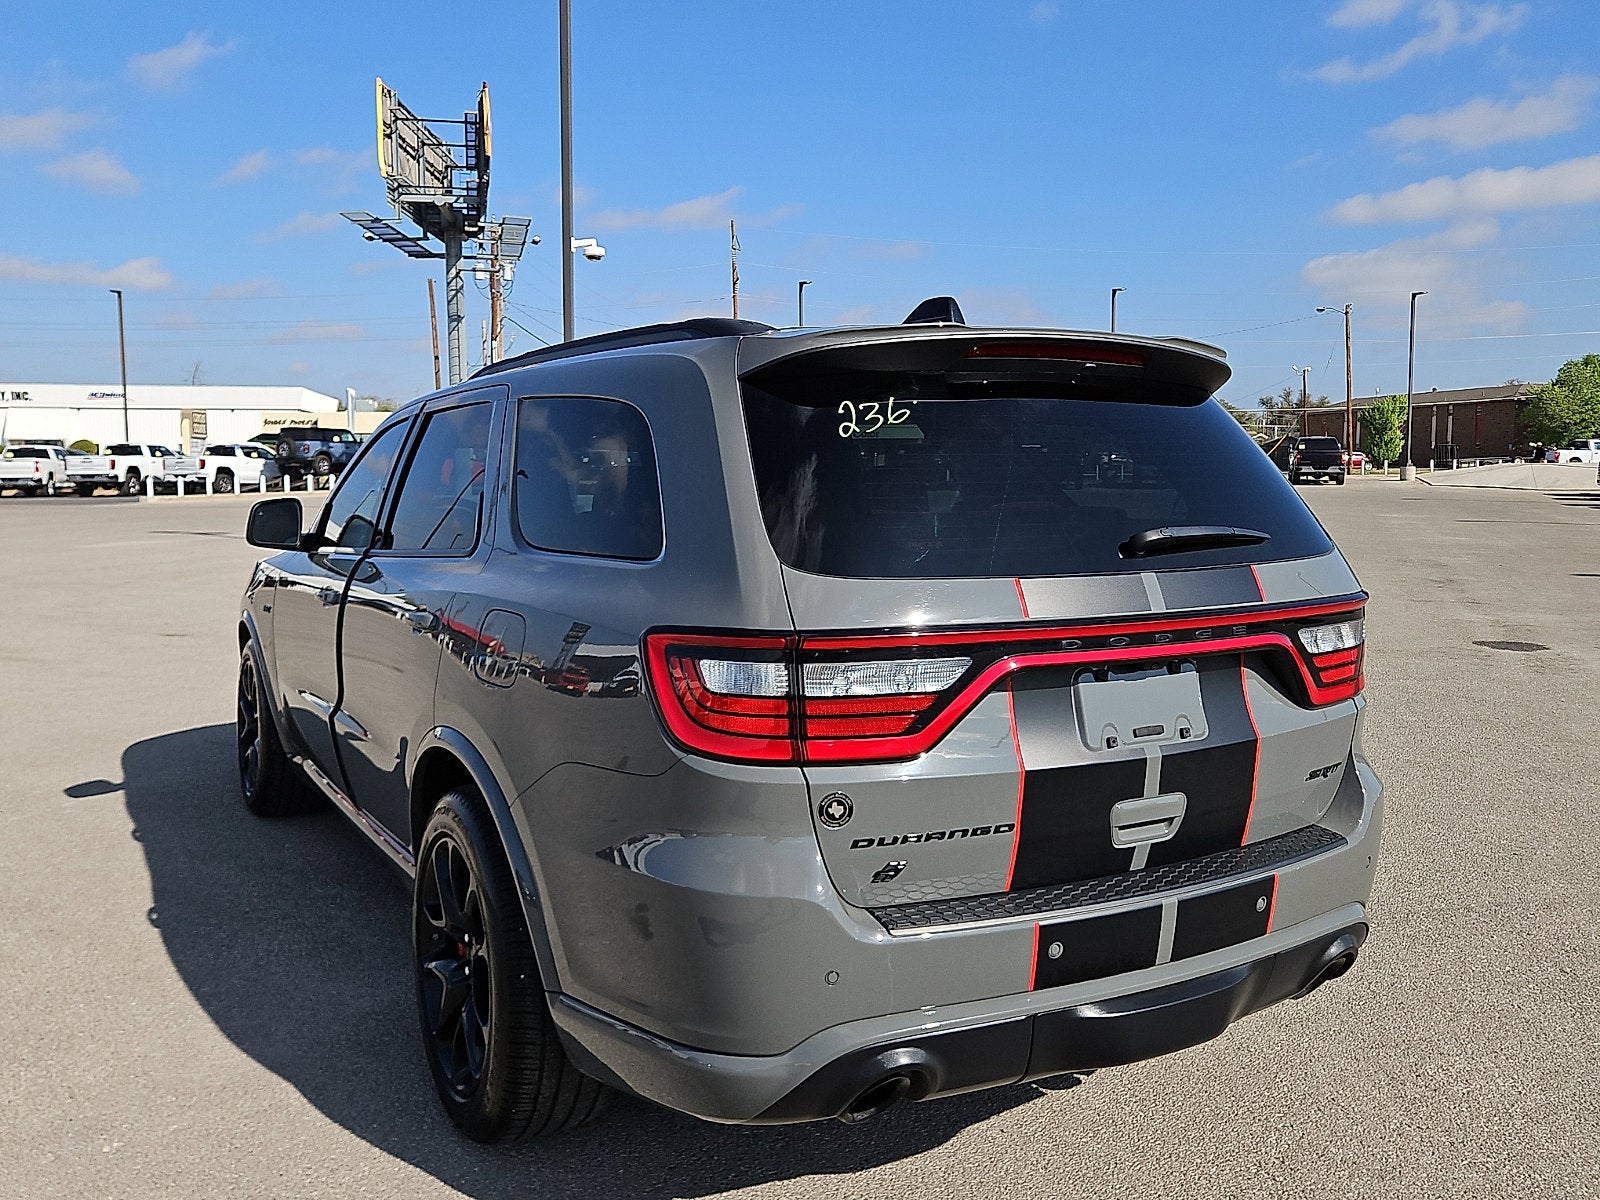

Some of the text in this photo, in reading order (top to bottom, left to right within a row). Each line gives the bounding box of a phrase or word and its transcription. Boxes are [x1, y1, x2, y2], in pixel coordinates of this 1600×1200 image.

[12, 391, 34, 402] INC.
[838, 397, 911, 438] 236
[1061, 625, 1247, 650] DODGE
[849, 822, 1015, 850] DURANGO
